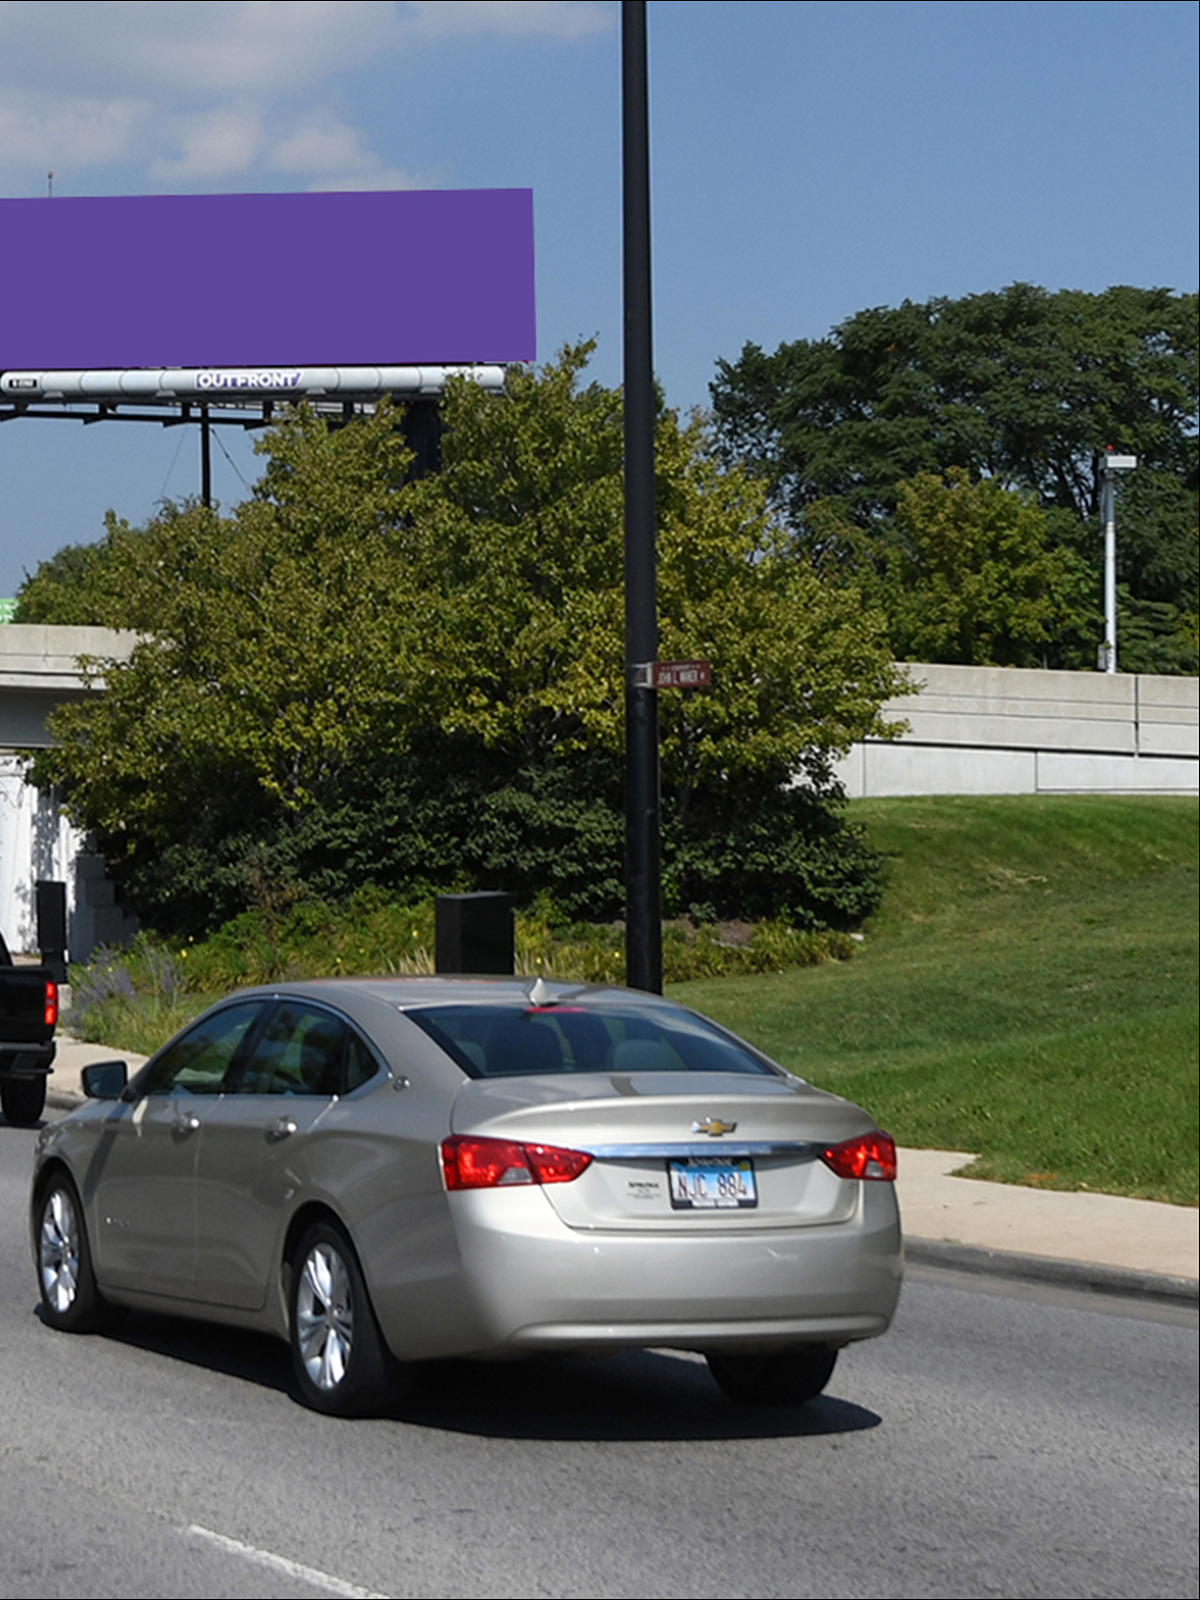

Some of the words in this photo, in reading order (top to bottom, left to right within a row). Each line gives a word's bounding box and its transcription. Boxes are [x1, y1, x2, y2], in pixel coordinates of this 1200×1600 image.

[198, 373, 298, 389] OUTFRONT
[678, 1173, 707, 1198] NJC
[717, 1173, 747, 1197] 884
